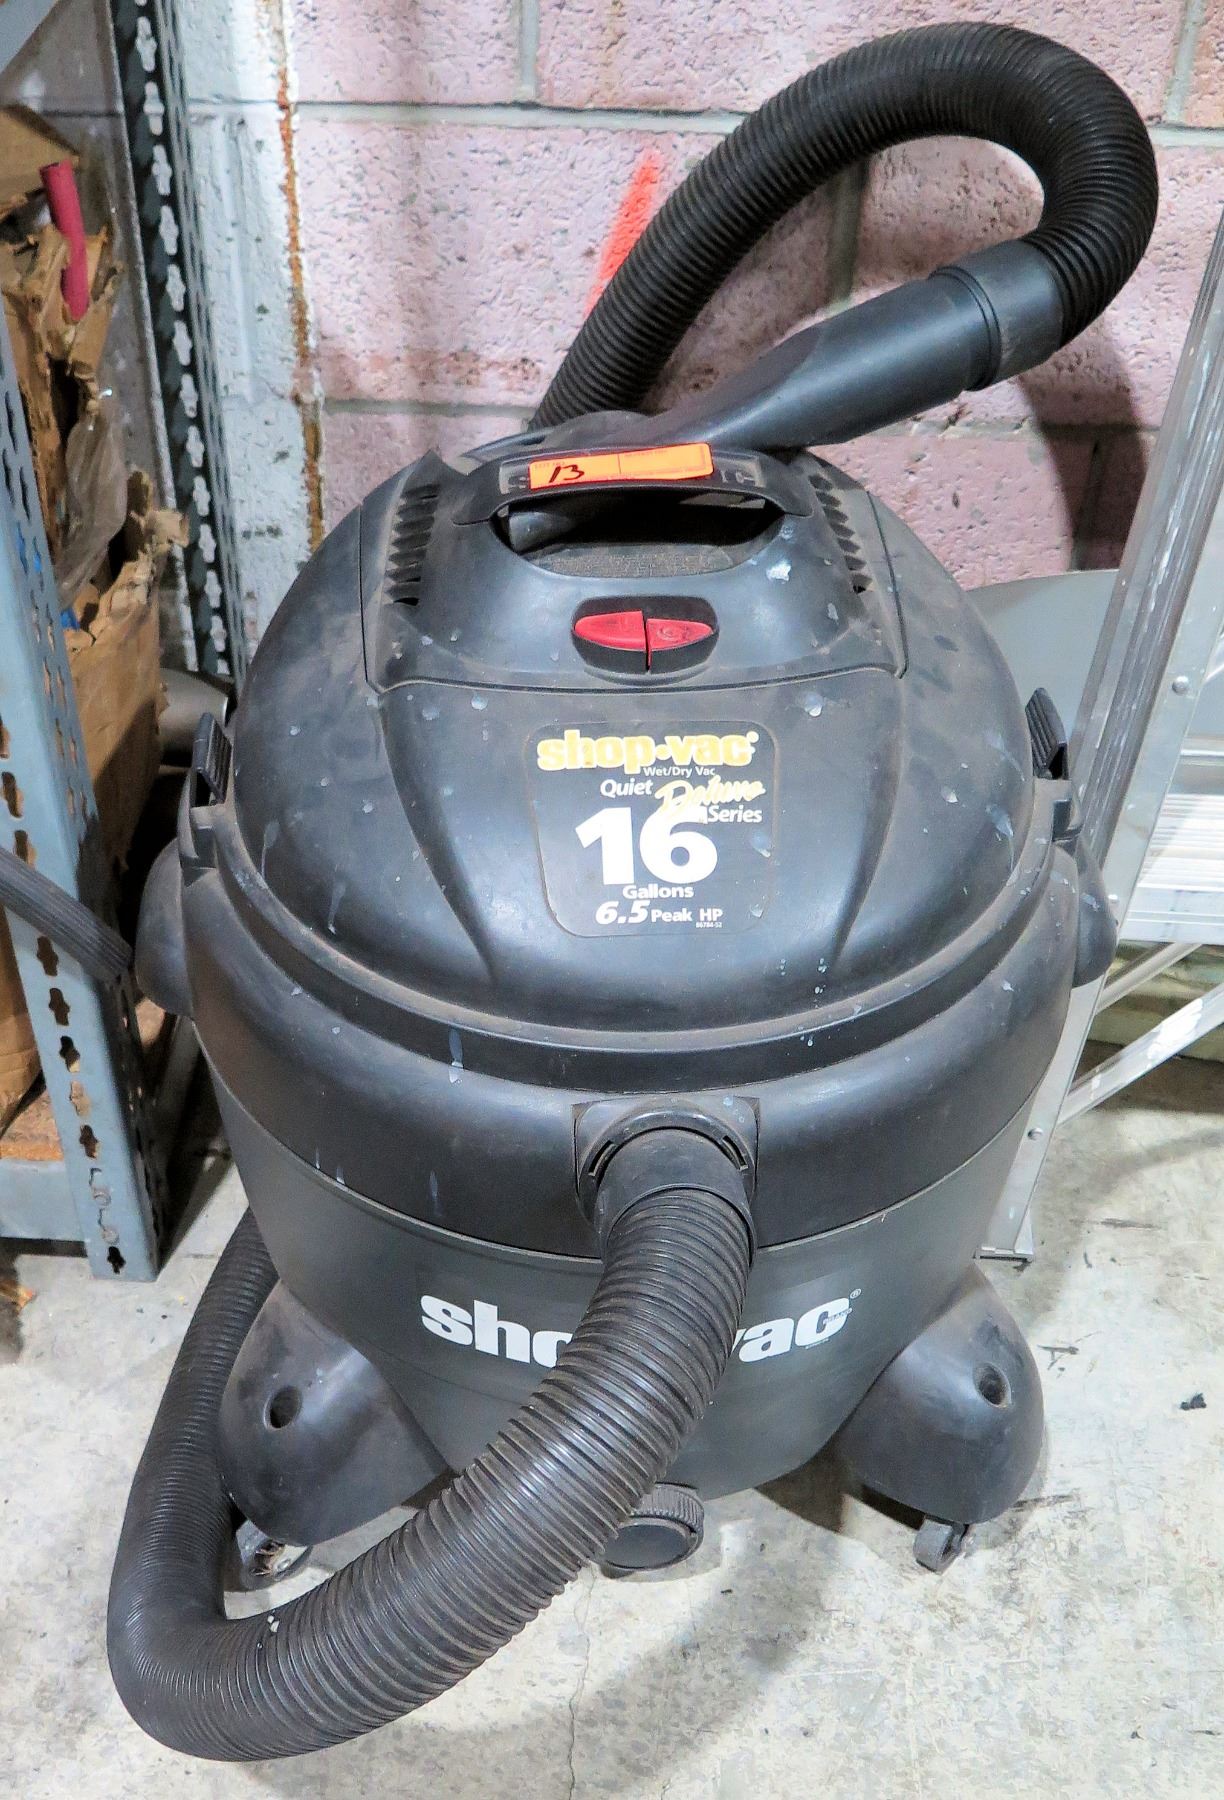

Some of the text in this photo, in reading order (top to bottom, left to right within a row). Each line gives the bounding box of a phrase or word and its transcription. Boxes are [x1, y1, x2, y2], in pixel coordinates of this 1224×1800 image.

[548, 464, 585, 483] 13
[643, 765, 716, 779] Wet/Dry Vac
[600, 778, 654, 799] Quiet
[707, 804, 763, 823] Series
[575, 806, 718, 885] 16
[622, 883, 695, 900] Gallons
[595, 900, 724, 925] 6.5 Peak HP
